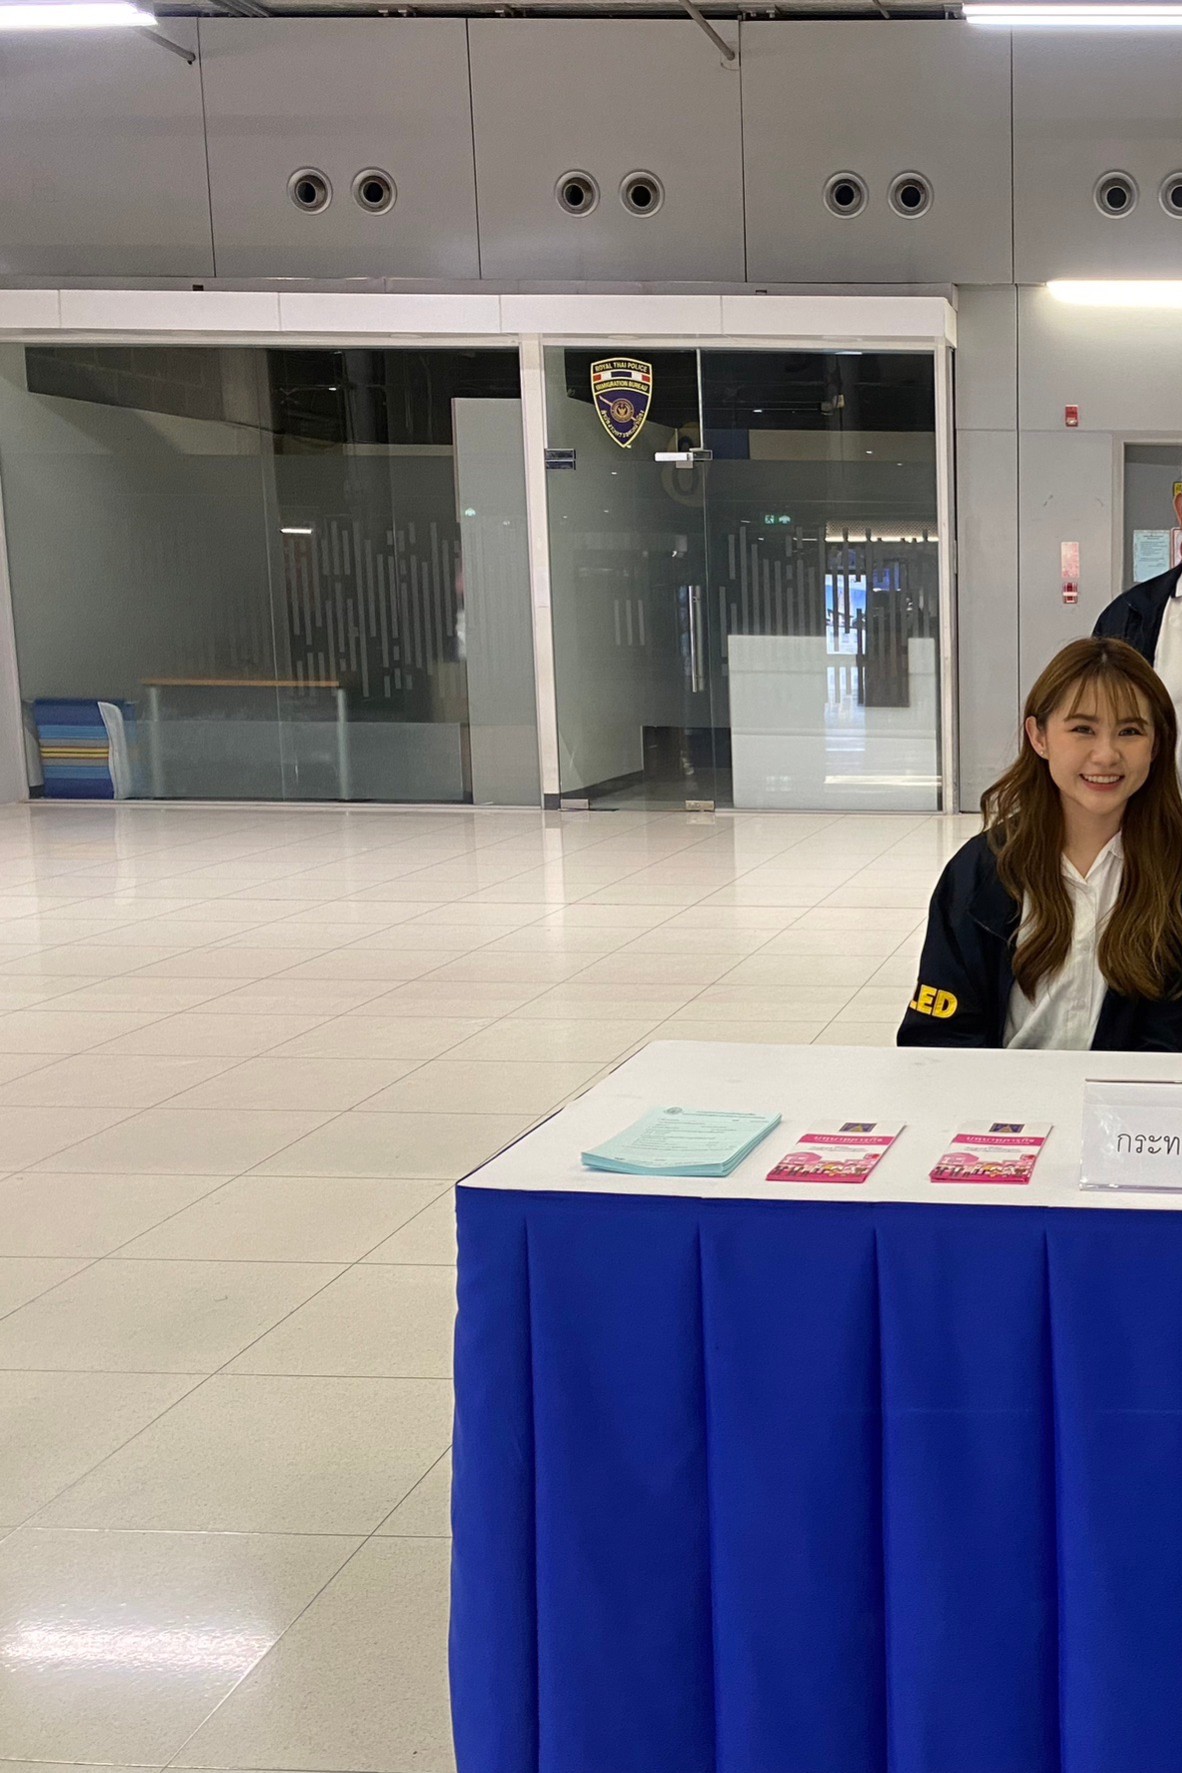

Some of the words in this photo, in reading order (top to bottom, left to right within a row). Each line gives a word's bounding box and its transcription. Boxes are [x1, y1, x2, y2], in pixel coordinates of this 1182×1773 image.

[595, 362, 612, 372] ROYAL
[613, 361, 627, 369] THAI
[628, 362, 648, 373] POLICE
